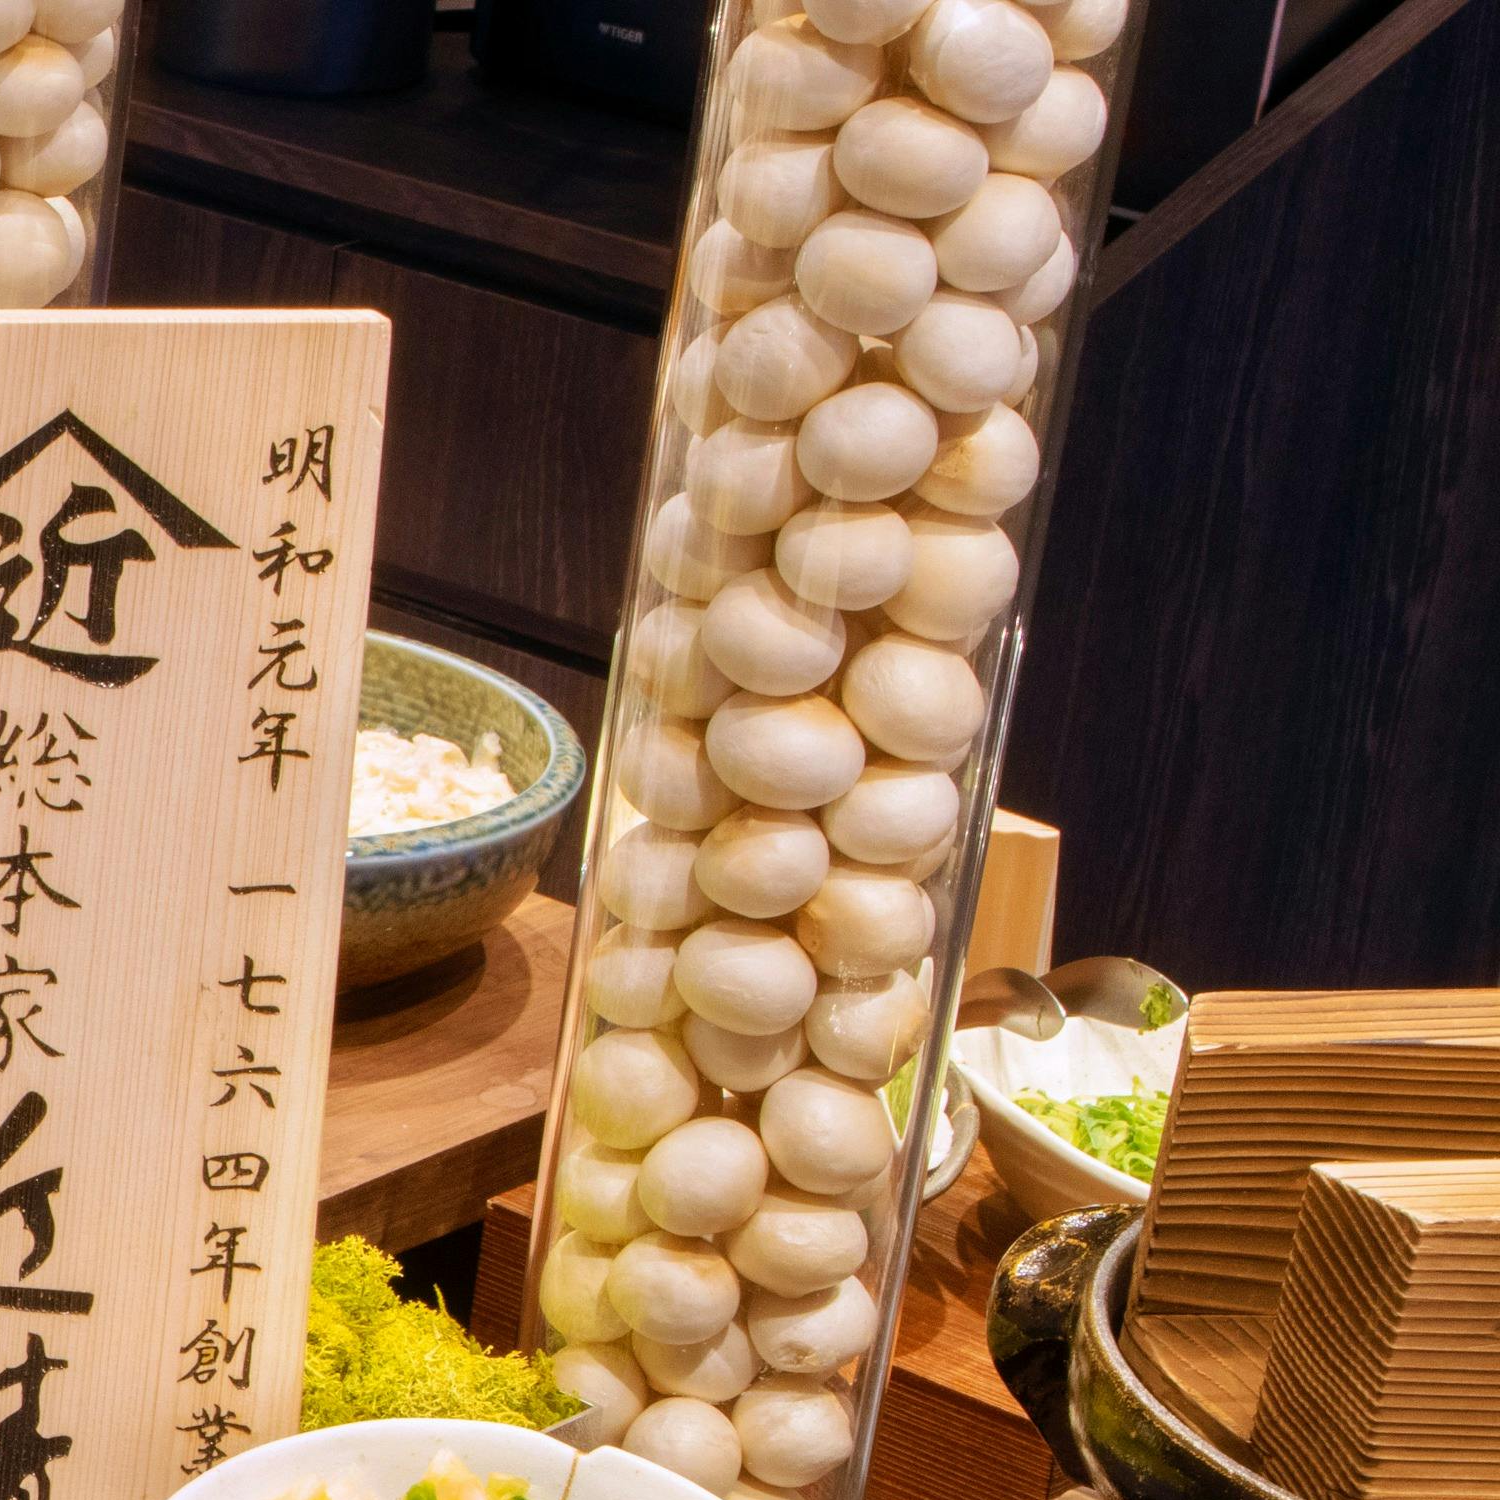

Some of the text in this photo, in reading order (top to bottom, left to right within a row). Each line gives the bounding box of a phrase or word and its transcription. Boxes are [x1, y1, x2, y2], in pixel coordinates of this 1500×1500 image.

[176, 423, 336, 1477] 明和元年 一七六四年創業
